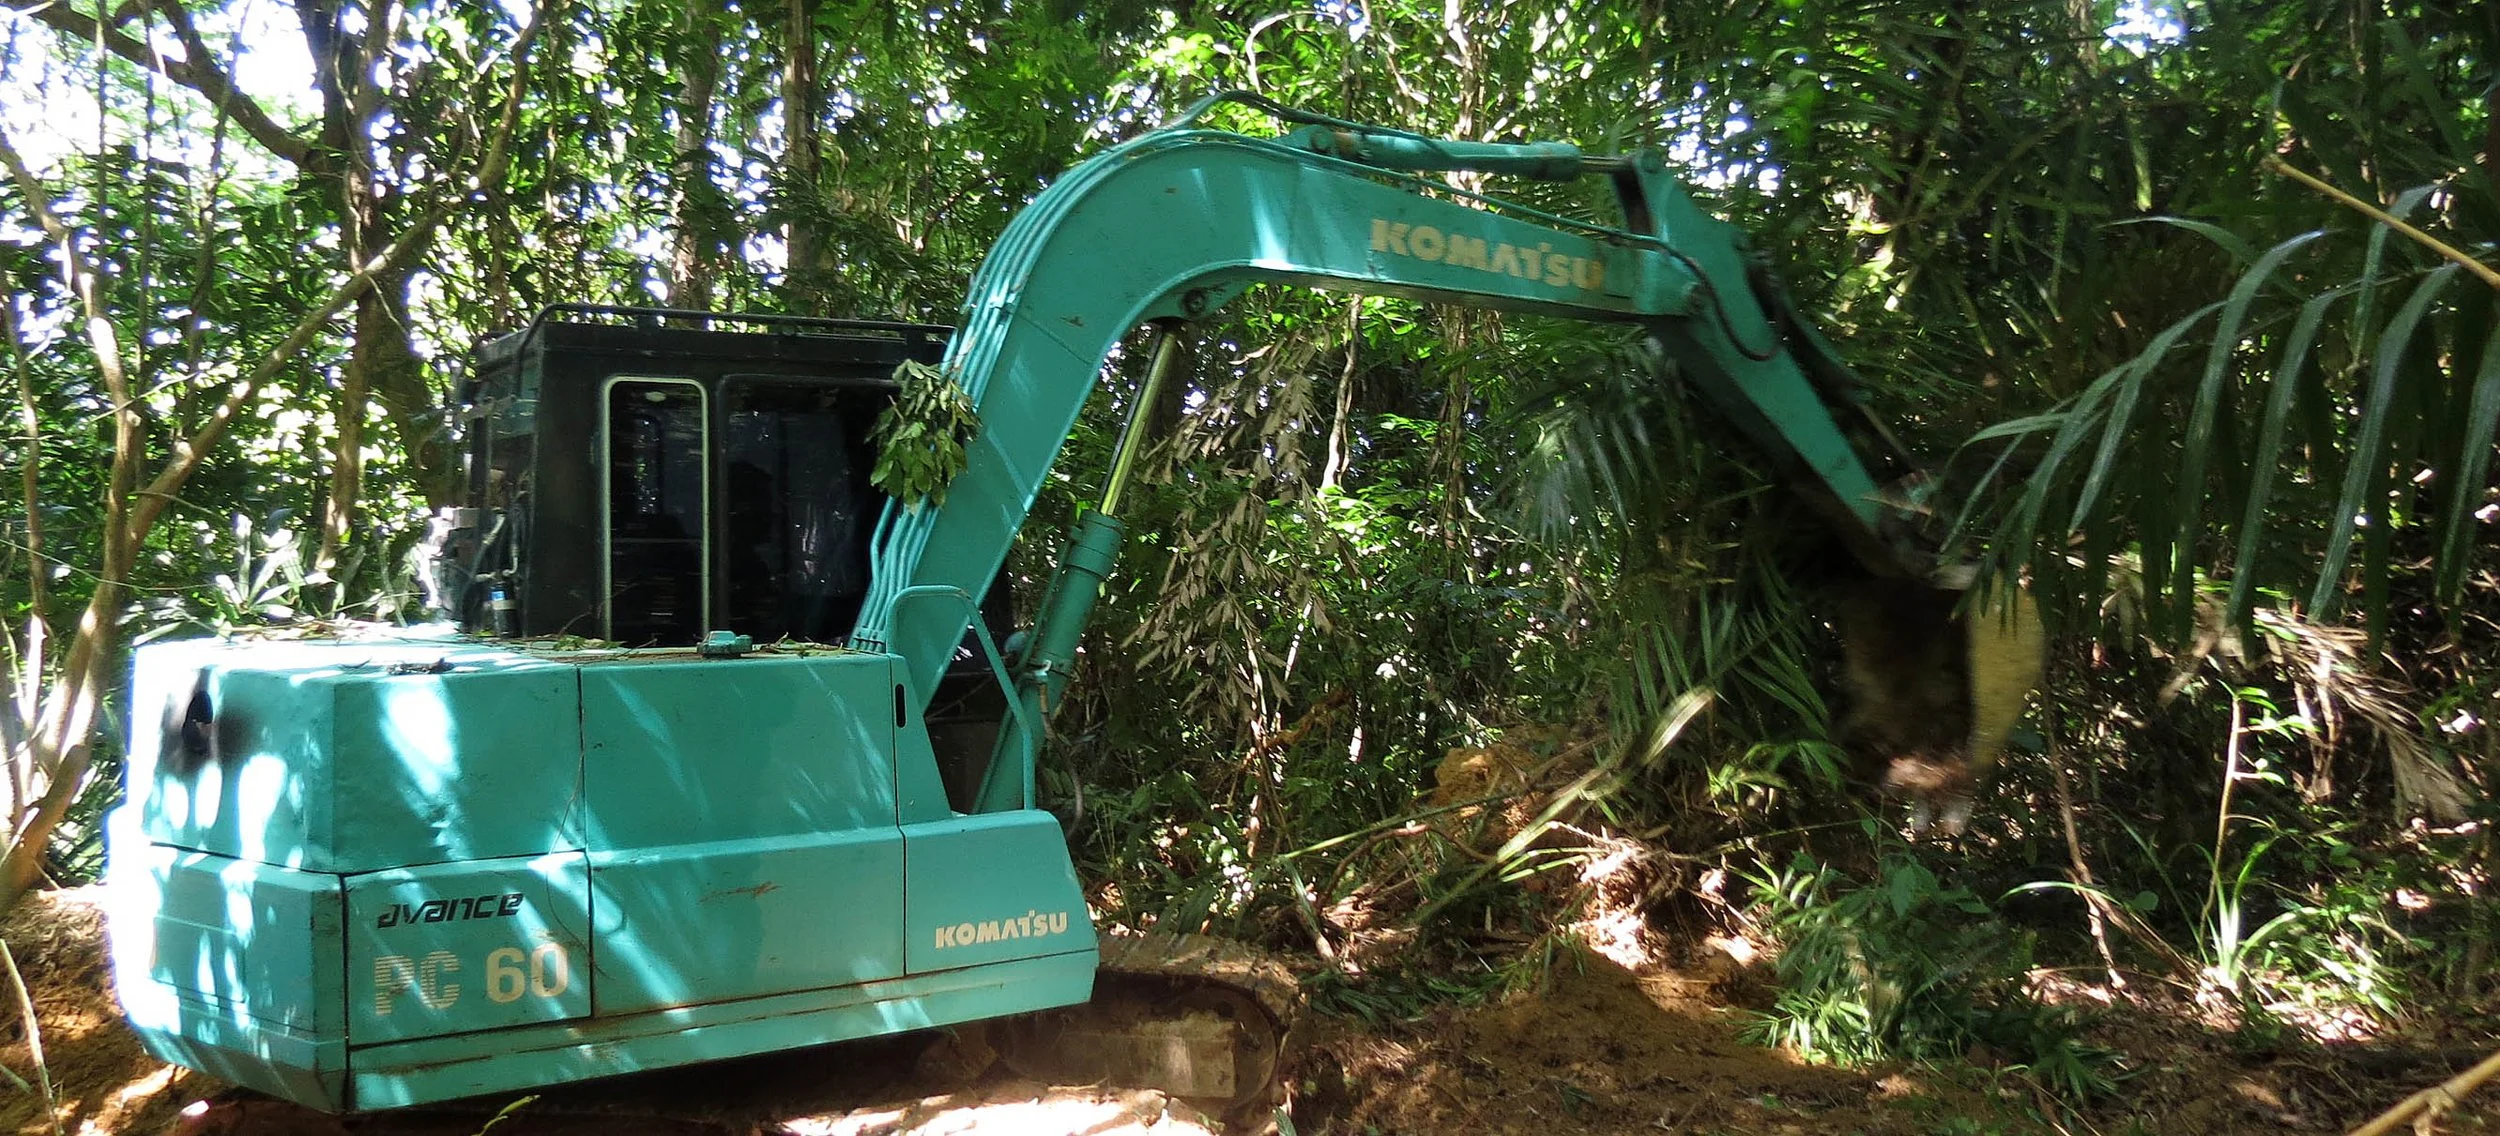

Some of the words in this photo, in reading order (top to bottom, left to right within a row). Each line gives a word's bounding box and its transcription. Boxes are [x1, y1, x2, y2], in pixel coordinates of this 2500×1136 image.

[1371, 218, 1604, 290] KOMATSU
[377, 893, 524, 928] avance
[935, 909, 1068, 949] KOMATSU
[374, 951, 461, 1015] PC
[486, 941, 568, 1004] 60
